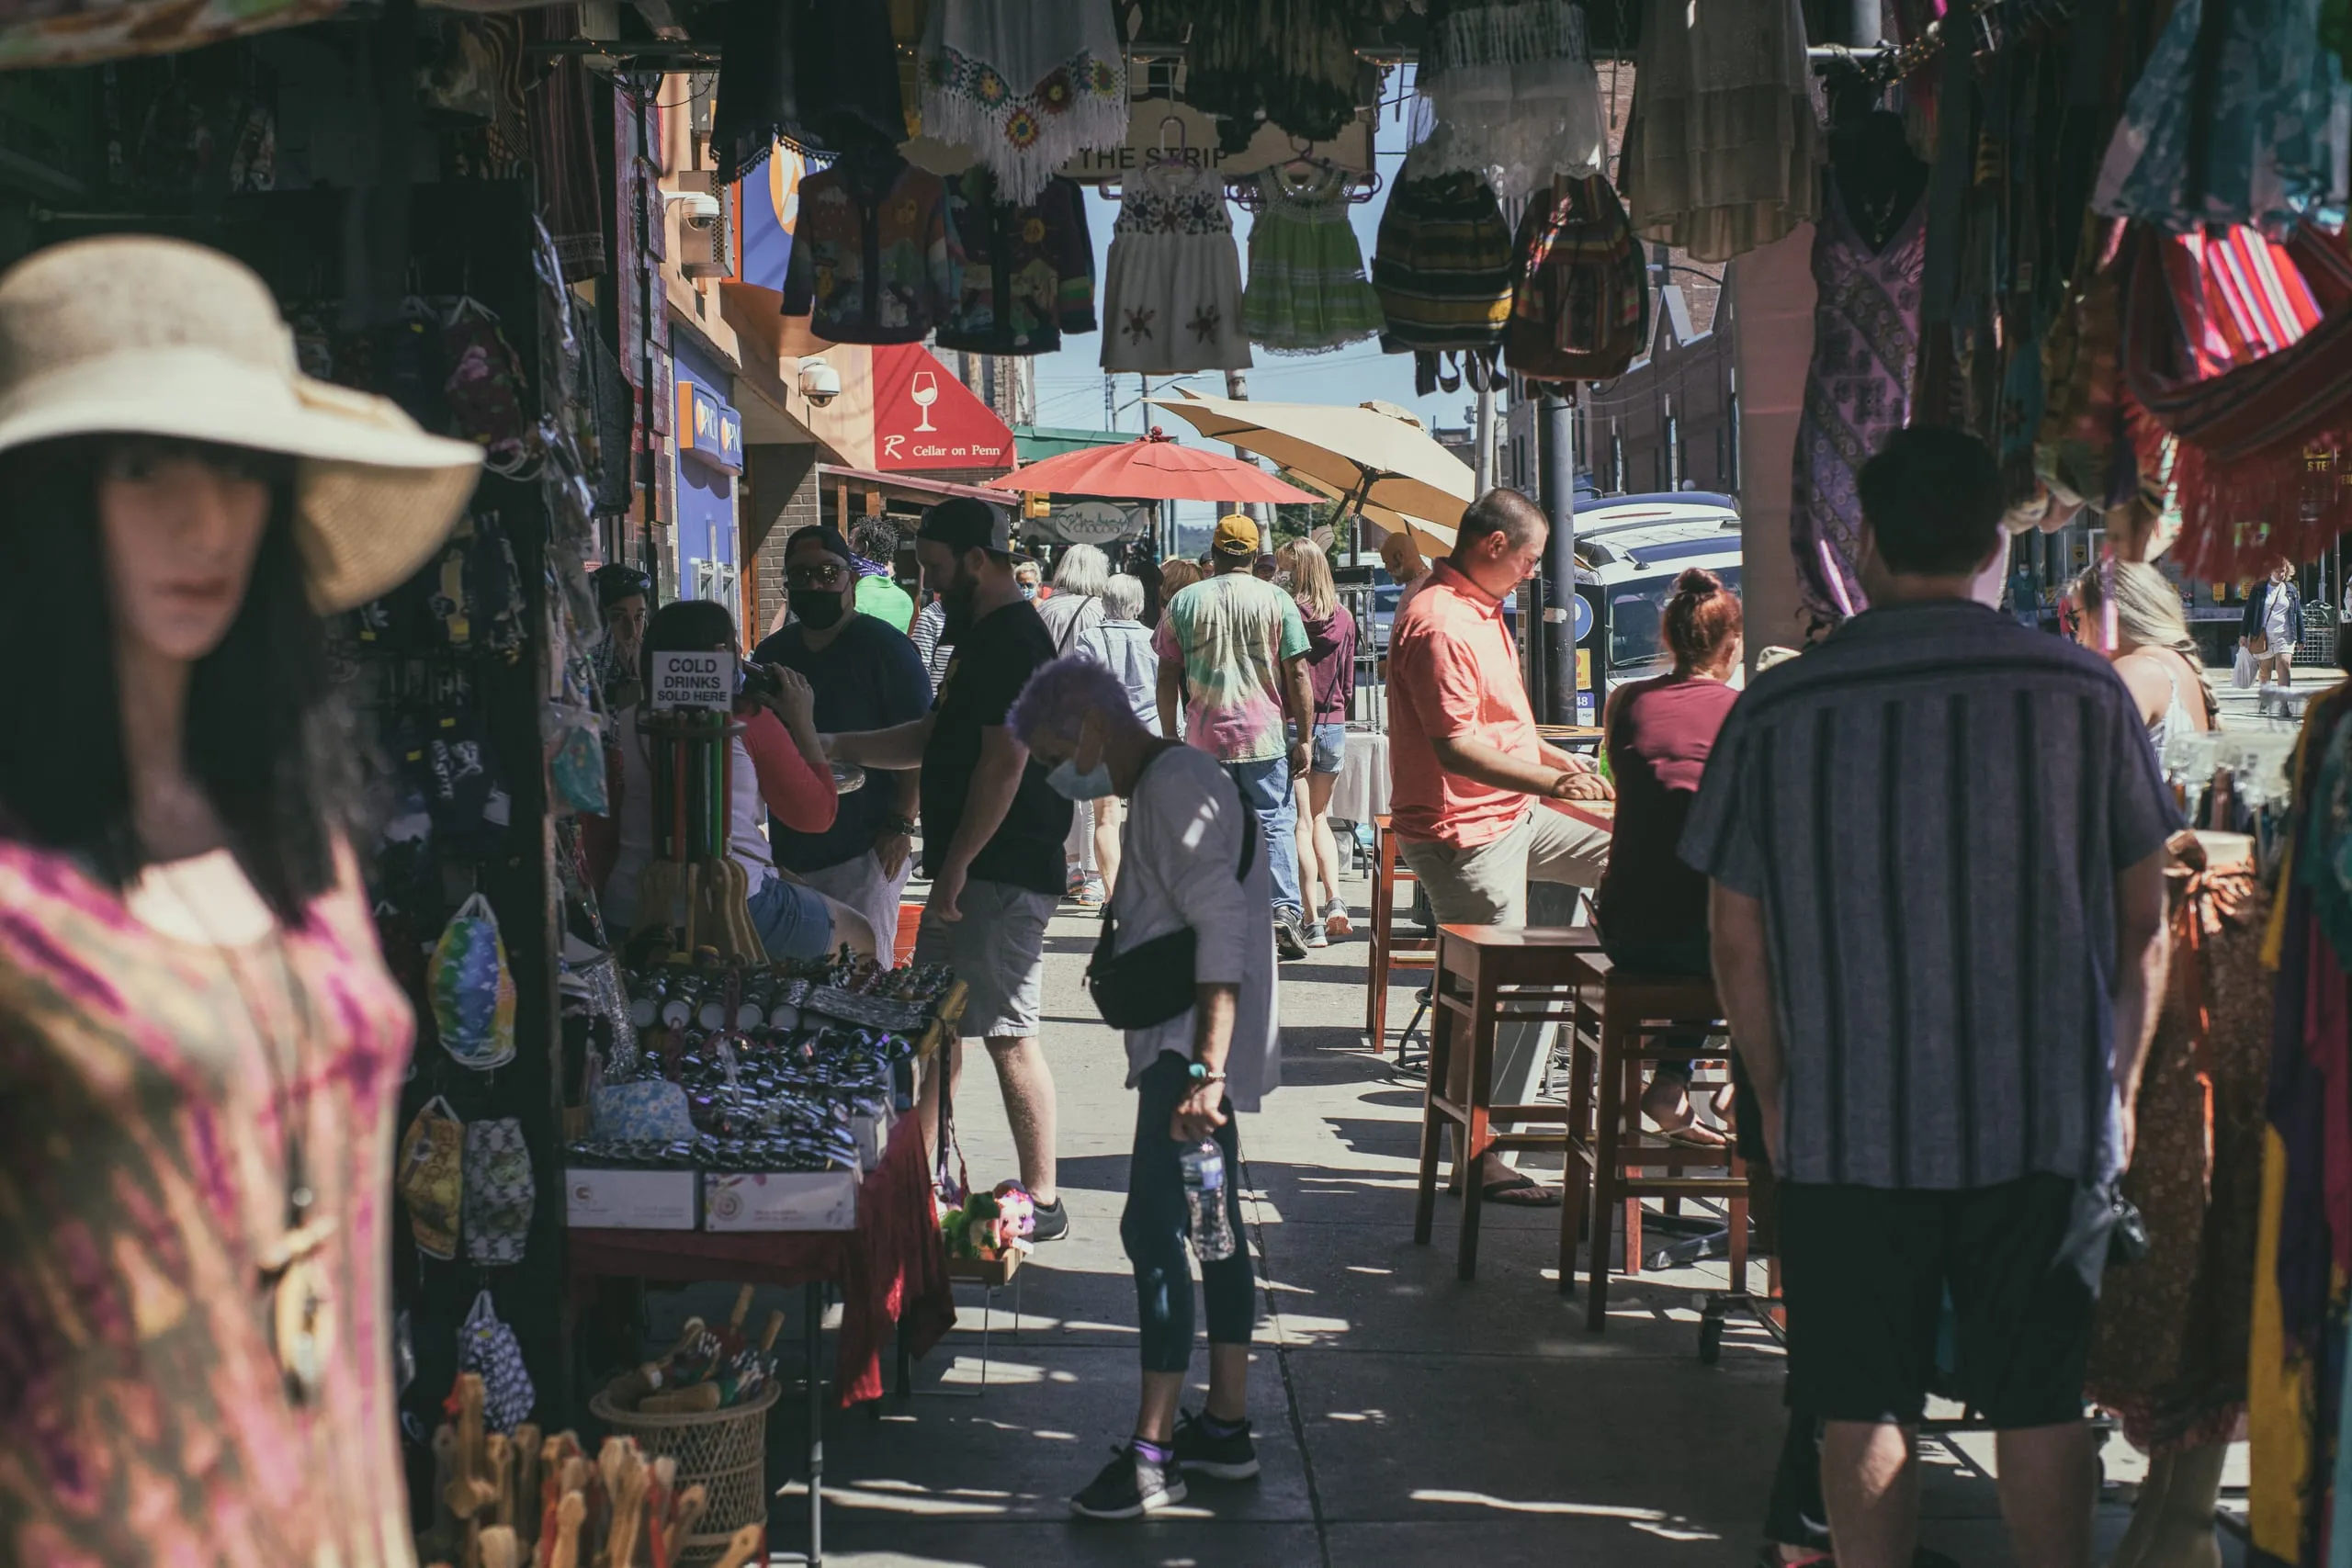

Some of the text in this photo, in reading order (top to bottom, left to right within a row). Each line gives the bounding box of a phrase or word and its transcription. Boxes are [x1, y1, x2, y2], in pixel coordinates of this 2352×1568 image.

[1079, 147, 1136, 170] THE
[1146, 147, 1229, 170] STRIP
[884, 434, 1001, 460] R Cellar on Penn
[668, 658, 718, 673] COLD
[663, 675, 721, 689] DRINKS
[657, 690, 728, 702] SOLD HERE
